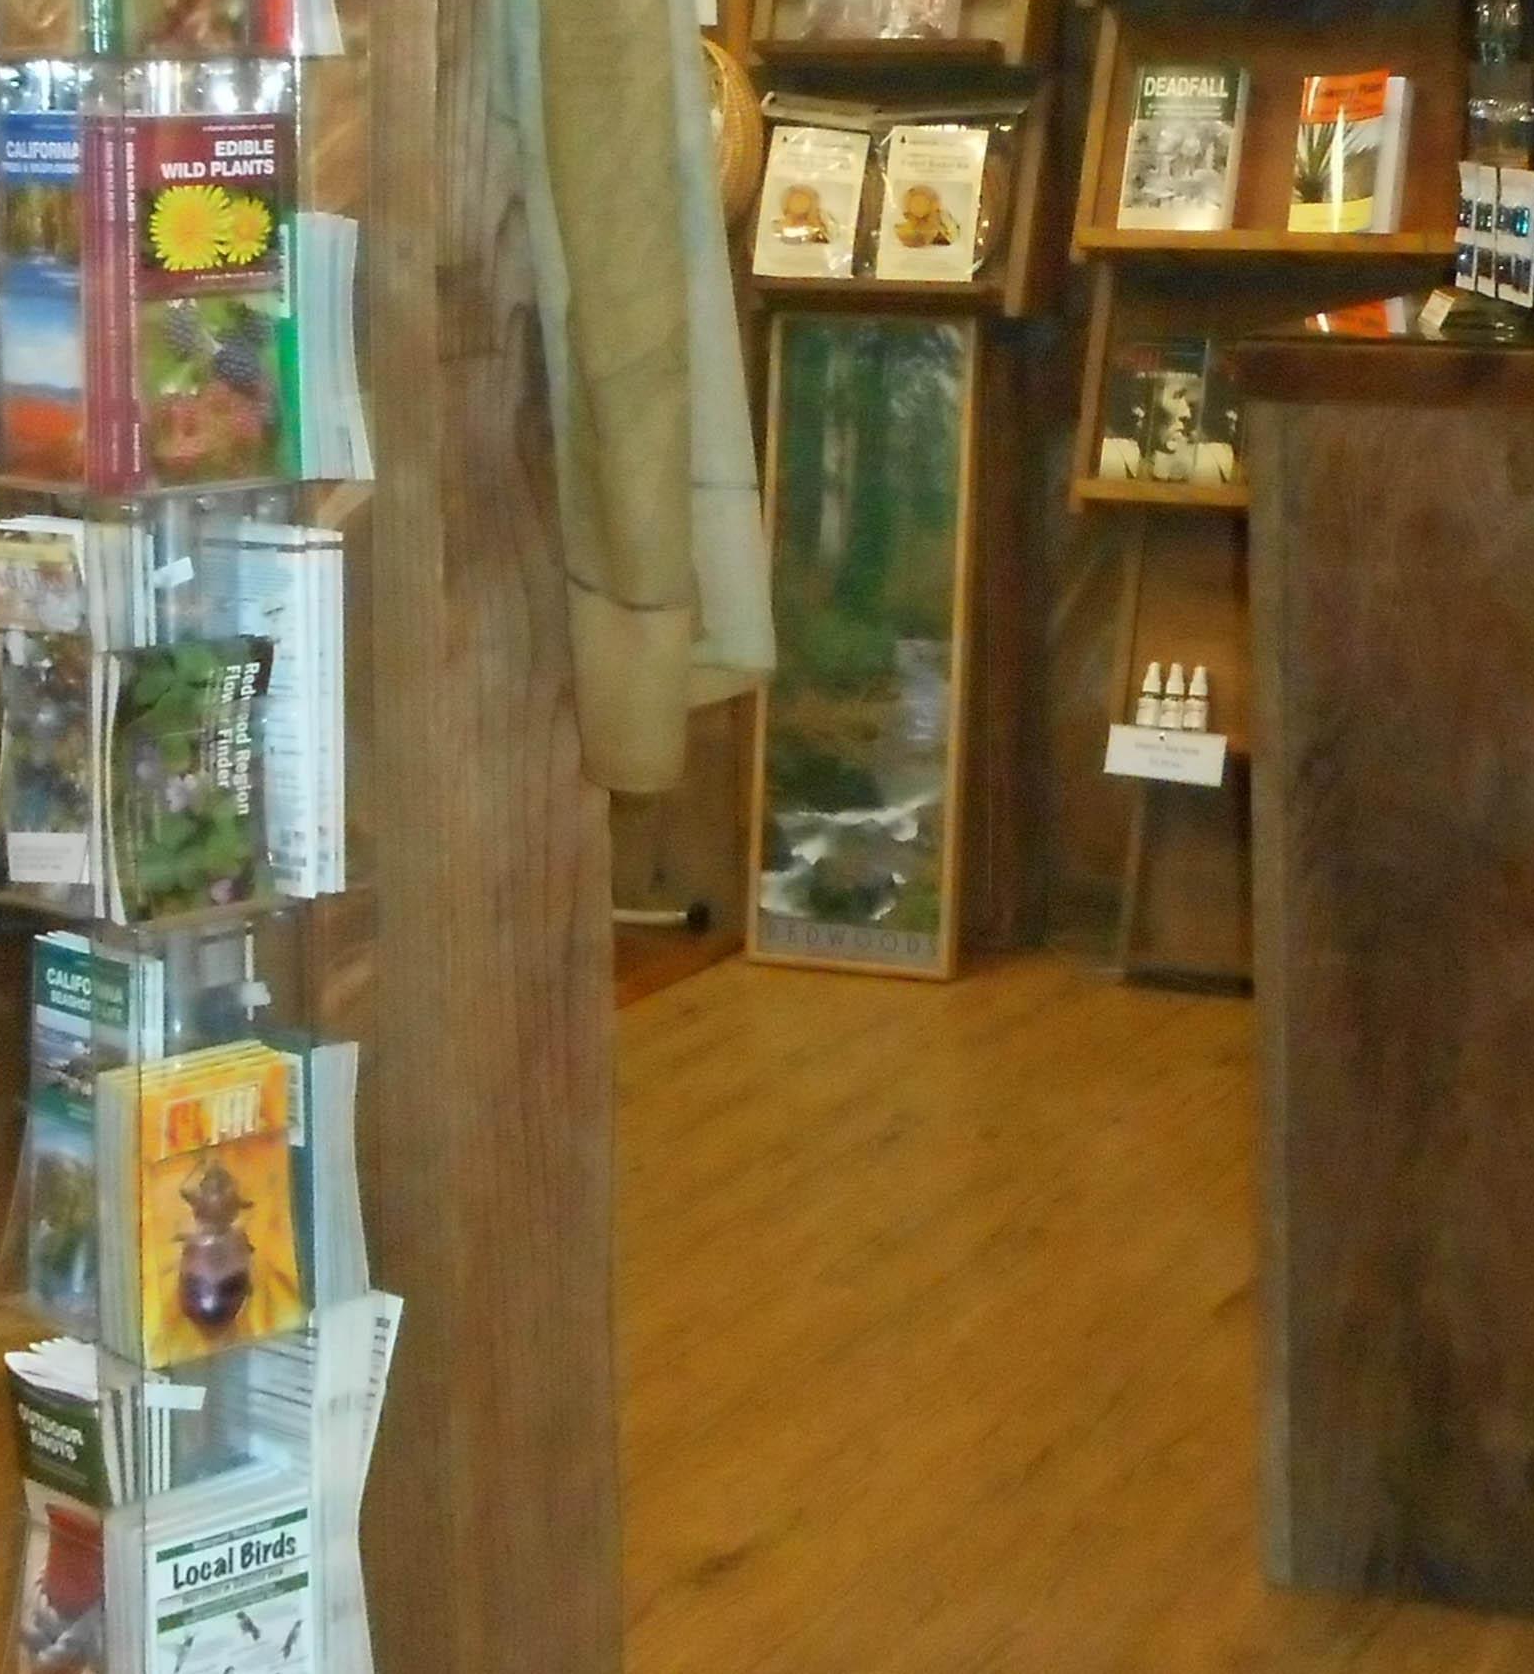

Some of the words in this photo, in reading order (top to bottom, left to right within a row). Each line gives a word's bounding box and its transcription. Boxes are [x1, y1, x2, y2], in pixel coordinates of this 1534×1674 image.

[1144, 77, 1229, 98] DEADFALL
[5, 141, 80, 159] CALIFORNIA
[215, 139, 275, 157] EDIBLE
[160, 162, 205, 179] WILD
[210, 159, 275, 177] PLANTS
[217, 728, 234, 788] Finder
[233, 749, 252, 816] Region
[173, 1546, 234, 1590] Local
[240, 1531, 297, 1570] Birds
